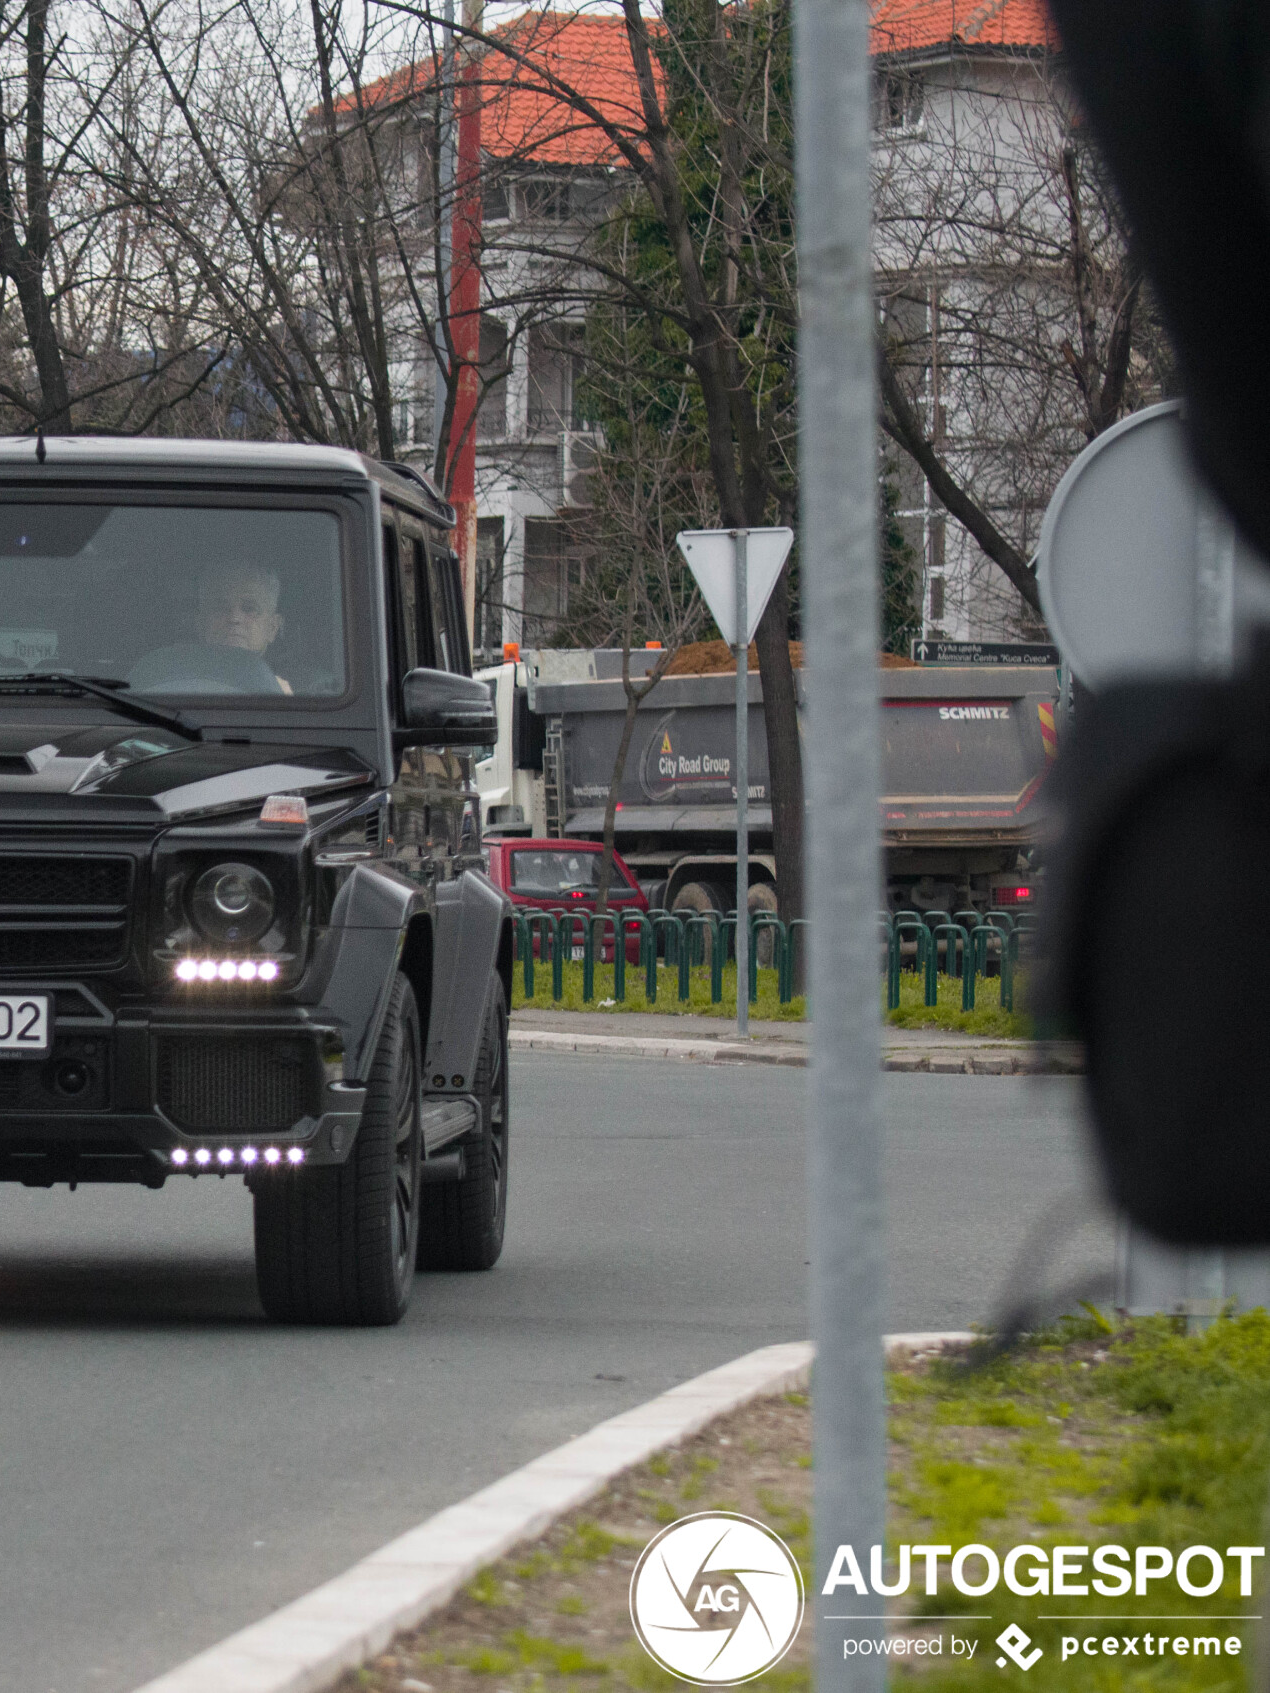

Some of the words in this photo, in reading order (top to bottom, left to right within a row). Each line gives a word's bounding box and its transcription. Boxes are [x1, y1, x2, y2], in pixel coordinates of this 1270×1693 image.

[937, 653, 971, 662] Memorial
[973, 654, 998, 662] Centre
[939, 707, 1010, 720] SCHMITZ
[659, 758, 677, 778] City
[679, 756, 701, 774] Road
[703, 755, 730, 775] Group
[732, 785, 766, 799] SMITZ
